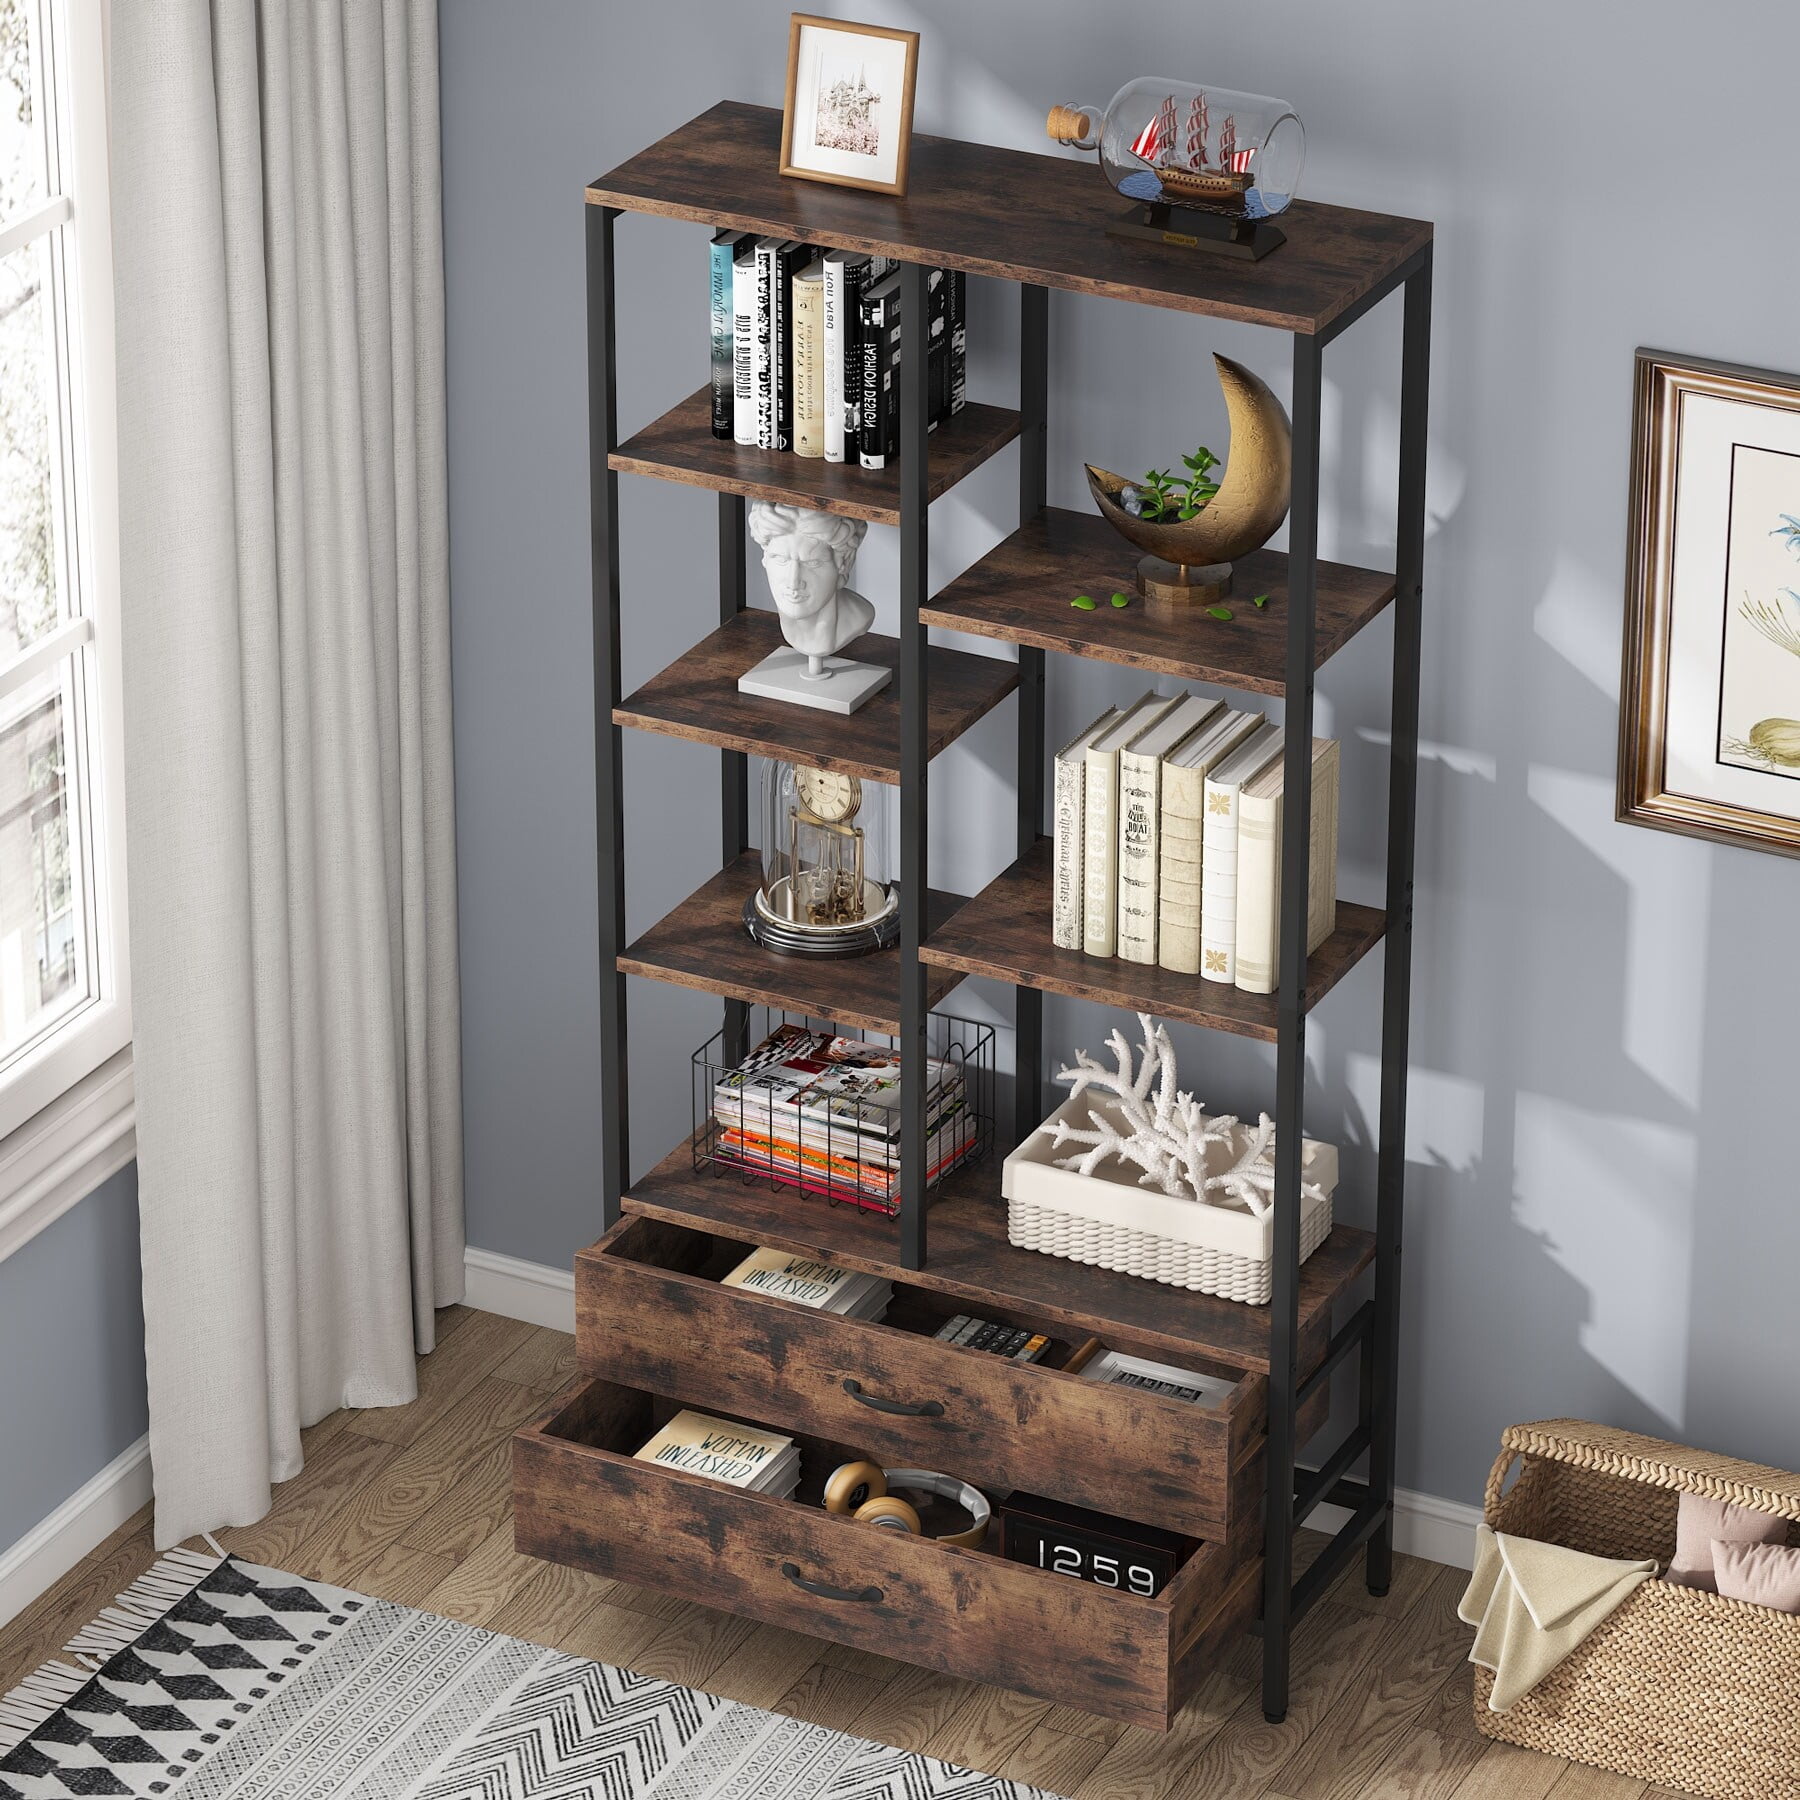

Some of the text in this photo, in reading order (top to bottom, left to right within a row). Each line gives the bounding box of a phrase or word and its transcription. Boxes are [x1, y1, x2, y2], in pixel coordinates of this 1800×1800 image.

[742, 1269, 829, 1300] UNLEASHED
[783, 1258, 846, 1285] WOMAN
[655, 1443, 752, 1480] UNLEASHED
[700, 1432, 772, 1464] WOMAN
